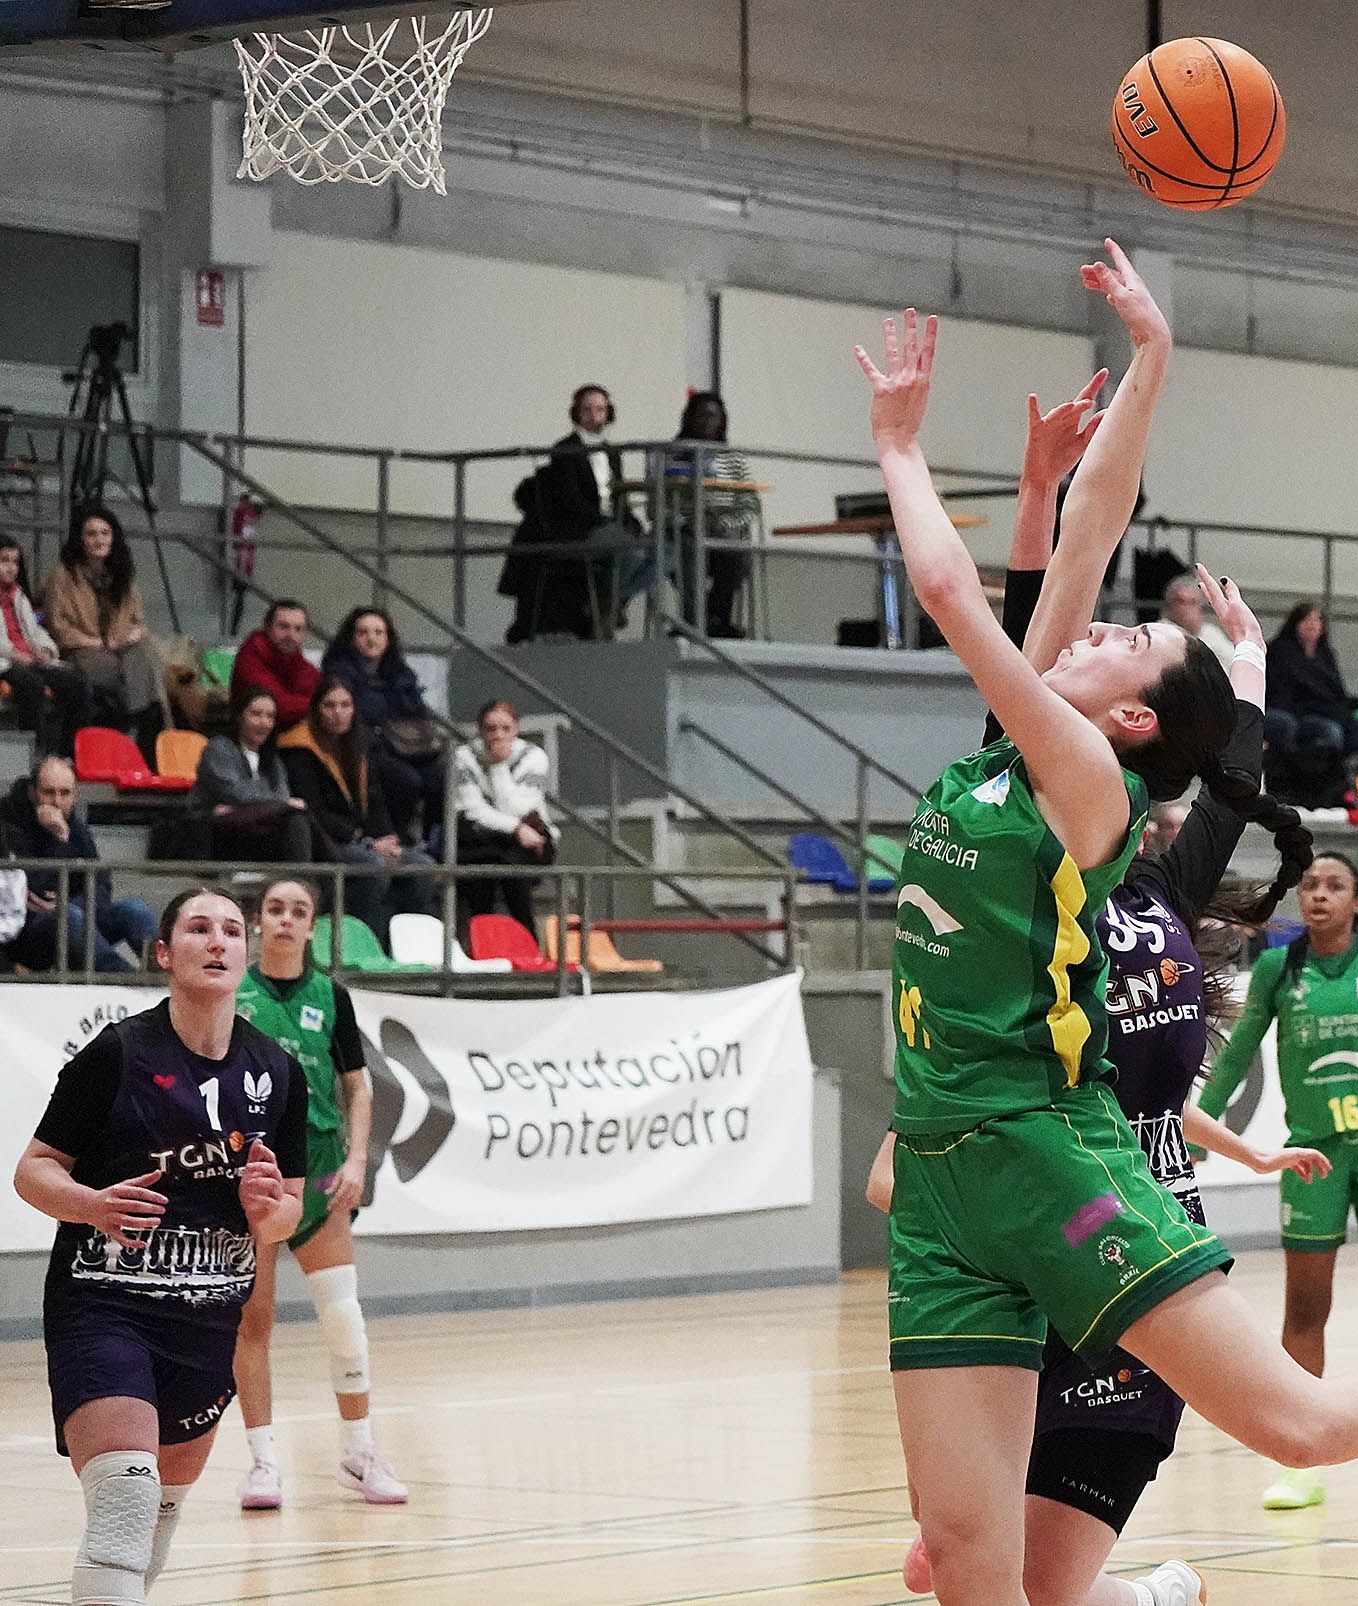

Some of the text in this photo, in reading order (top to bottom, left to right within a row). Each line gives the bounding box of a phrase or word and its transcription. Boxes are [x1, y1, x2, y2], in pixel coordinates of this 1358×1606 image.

[909, 829, 979, 870] DE GALICIA
[1105, 969, 1159, 1015] GN
[1120, 1004, 1199, 1034] BASQUET
[467, 1032, 742, 1107] Deputación
[198, 1077, 222, 1131] 1
[484, 1098, 749, 1159] Pontevedra
[150, 1140, 229, 1173] TGN
[193, 1165, 245, 1179] BASQUE
[1060, 1376, 1115, 1404] TGN
[1087, 1390, 1143, 1407] BASQUET
[179, 1404, 220, 1430] TGN
